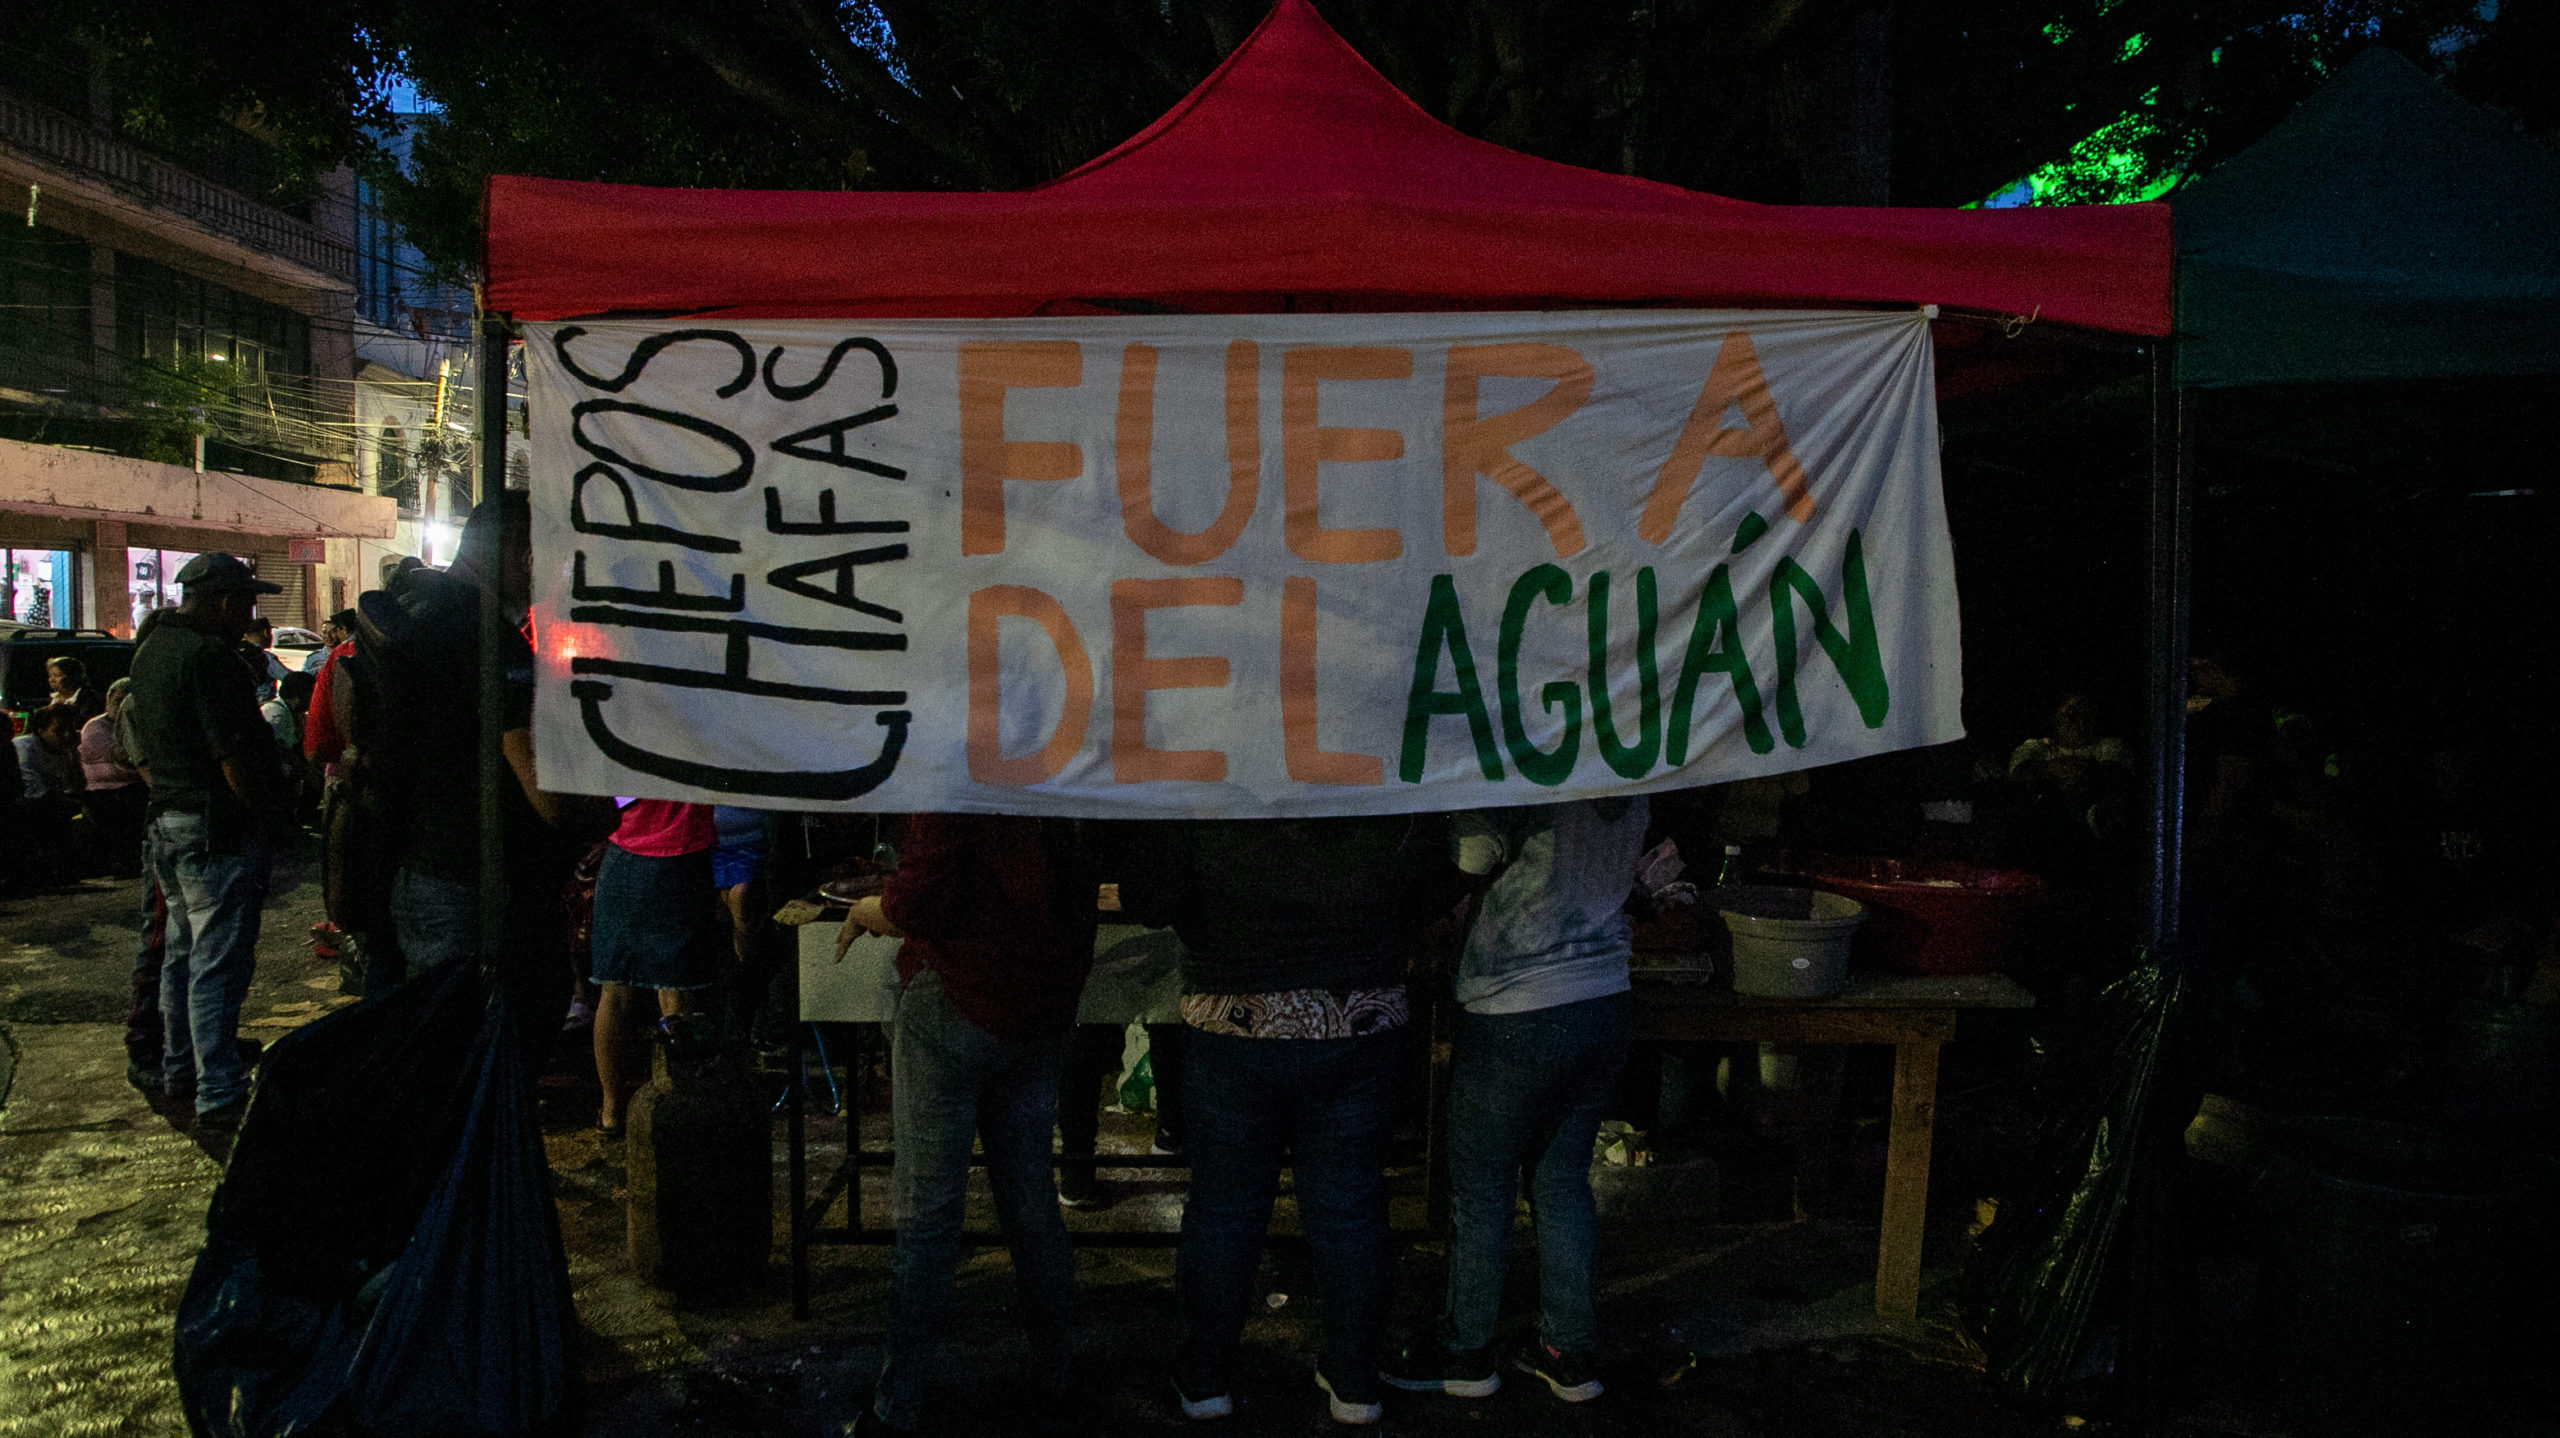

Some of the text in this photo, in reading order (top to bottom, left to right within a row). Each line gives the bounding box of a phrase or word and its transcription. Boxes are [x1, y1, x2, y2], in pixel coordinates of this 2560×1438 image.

[554, 325, 911, 800] CHEPOS
[958, 330, 1817, 566] FUERA
[966, 511, 1890, 786] DEL AGUÁN
